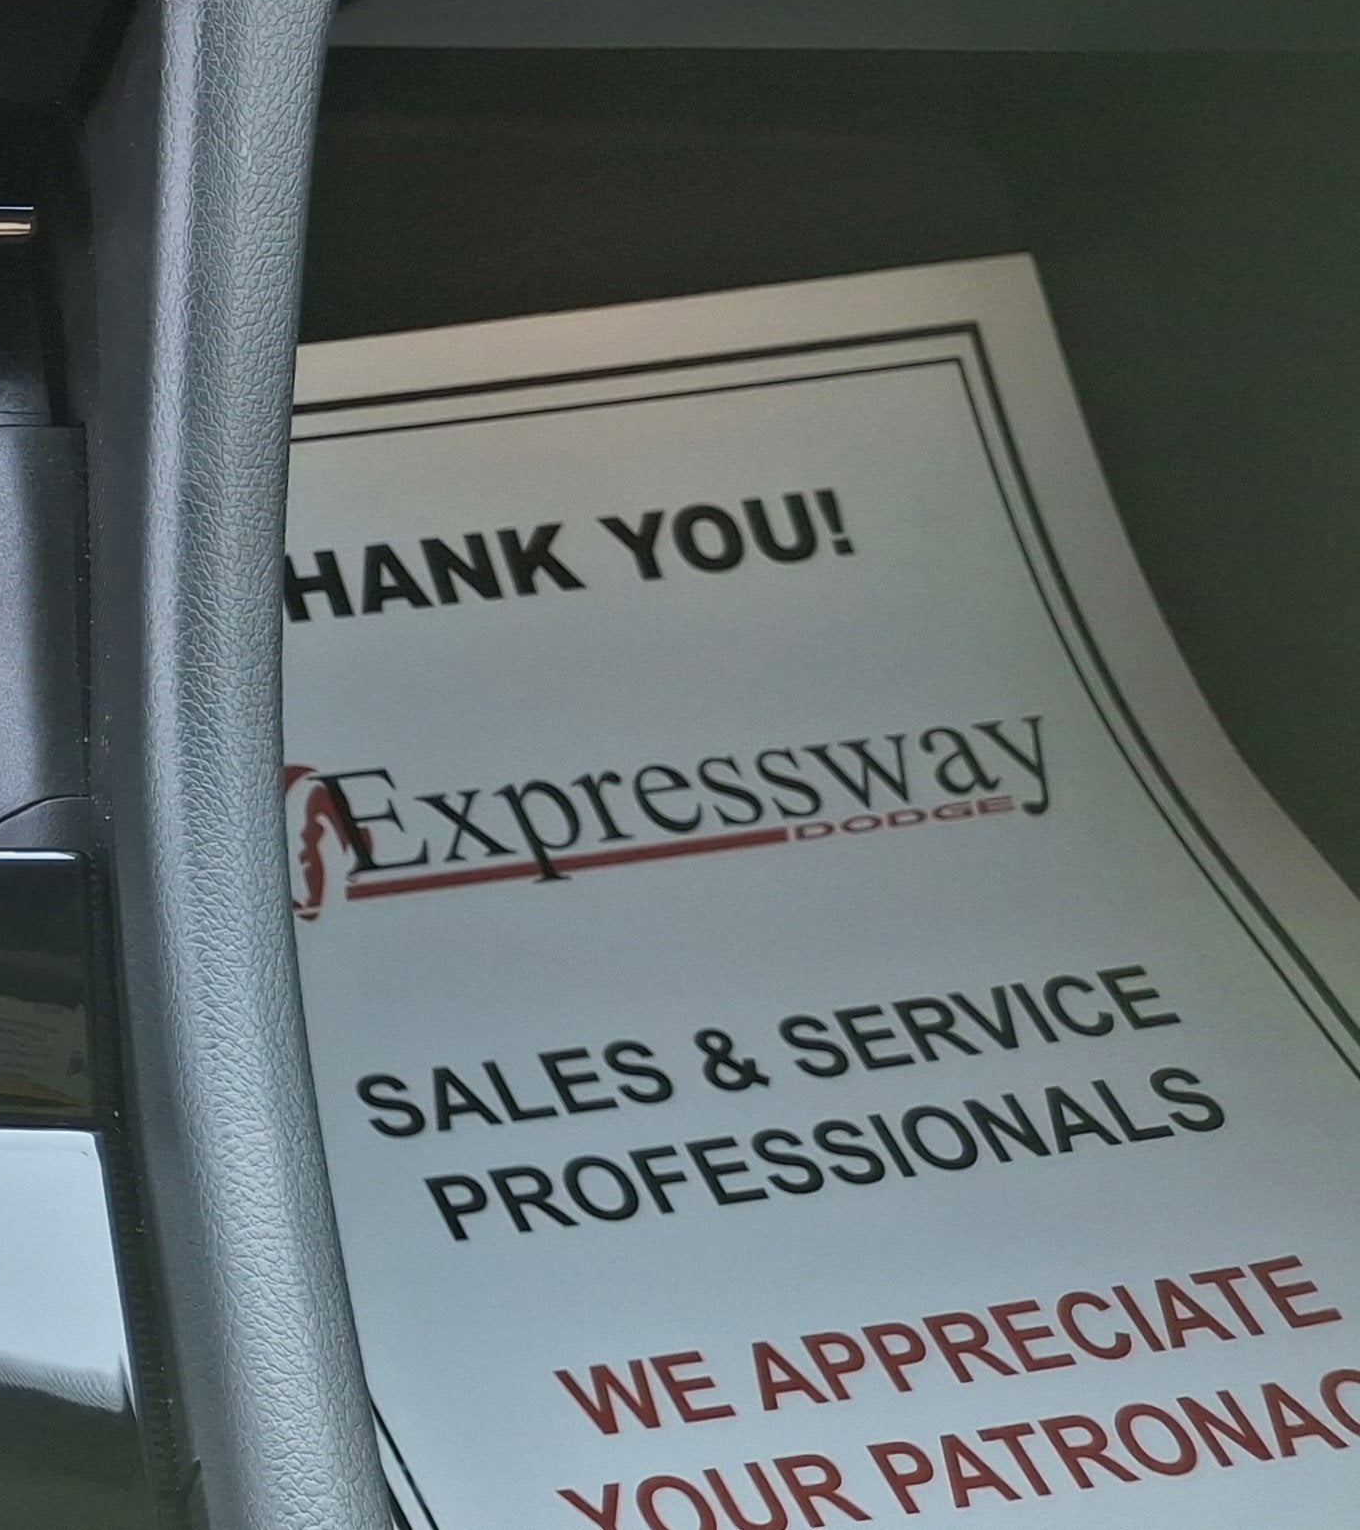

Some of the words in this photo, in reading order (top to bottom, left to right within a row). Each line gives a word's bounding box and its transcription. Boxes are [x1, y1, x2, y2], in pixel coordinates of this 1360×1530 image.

[282, 520, 587, 623] HANK
[599, 490, 854, 580] YOU!
[308, 713, 1050, 883] Expressway
[793, 795, 1016, 841] DODGE
[354, 1039, 675, 1138] SALES
[692, 1026, 770, 1092] &
[778, 964, 1181, 1080] SERVICE
[424, 1065, 1226, 1242] PROFESSIONALS
[553, 1350, 736, 1436] WE
[751, 1253, 1344, 1412] APPRECIATE
[555, 1450, 874, 1530] YOUR
